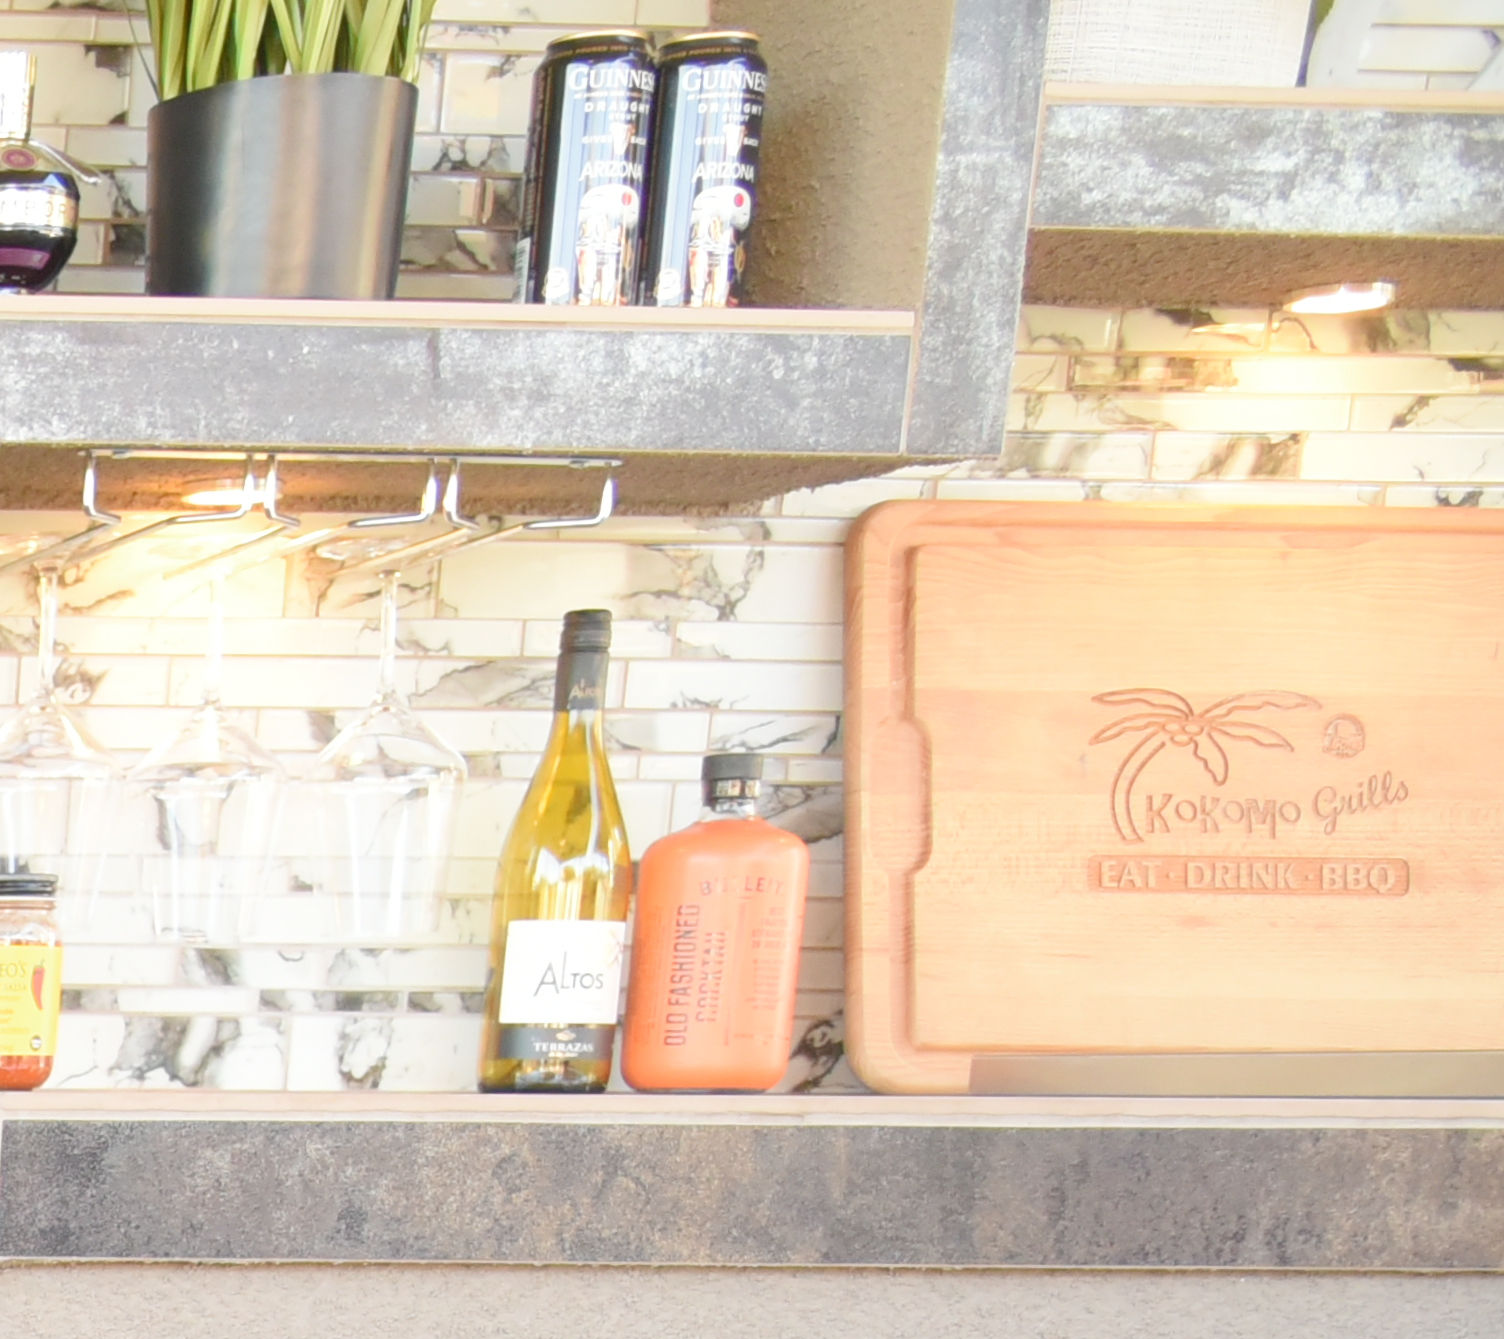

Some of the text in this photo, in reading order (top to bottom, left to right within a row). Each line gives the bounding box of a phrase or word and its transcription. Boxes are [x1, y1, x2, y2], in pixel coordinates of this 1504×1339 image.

[569, 67, 656, 93] GUINNES
[681, 68, 769, 92] GUINNES
[584, 101, 651, 114] DRAUGHT
[698, 102, 763, 115] DRAUGHT
[578, 160, 643, 183] ARIZONA
[691, 160, 755, 184] ARIZONA
[1312, 769, 1409, 836] Grills
[1097, 860, 1396, 894] EAT DRINK BBQ
[533, 950, 605, 998] ALTOS
[663, 902, 703, 1047] OLD FASHIONED
[532, 1040, 595, 1054] TERRAZAS
